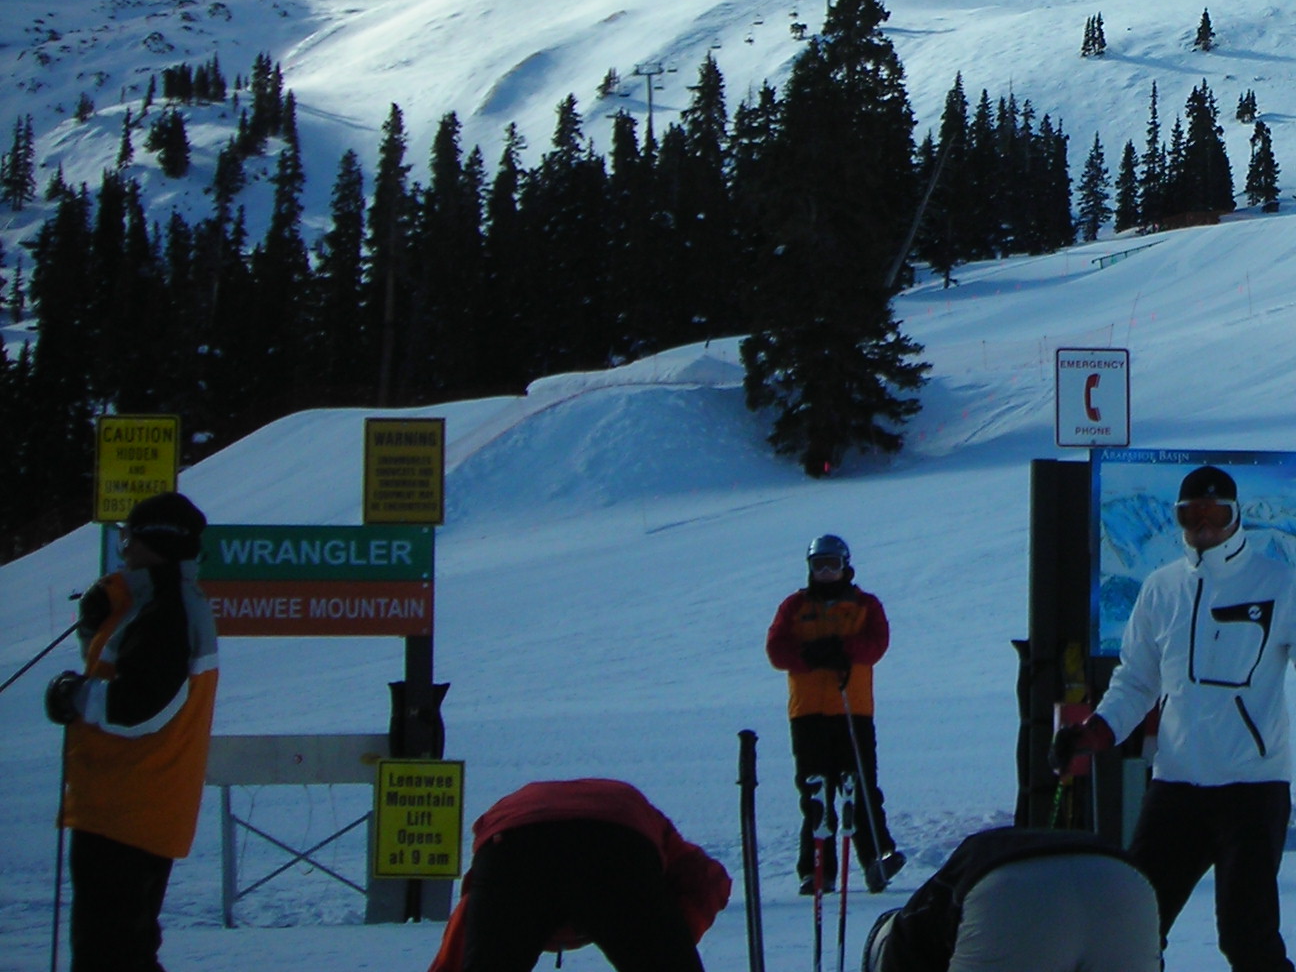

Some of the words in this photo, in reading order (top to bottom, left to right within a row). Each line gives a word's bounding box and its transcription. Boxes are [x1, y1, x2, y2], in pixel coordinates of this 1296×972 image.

[1060, 360, 1125, 369] EMERGENCY
[103, 426, 173, 443] CAUTION
[374, 431, 437, 446] WARNING
[1075, 427, 1112, 436] PHONE
[116, 446, 158, 461] HIDDEN
[128, 465, 146, 475] AND
[105, 479, 167, 494] UNMARKED
[219, 538, 413, 566] WRANGLER
[208, 597, 303, 619] ENAWEE
[309, 597, 425, 619] MOUNTAIN
[389, 772, 453, 788] Lenawee
[386, 791, 455, 807] Mountain
[407, 810, 432, 826] Lift
[397, 828, 443, 846] Opens
[389, 849, 404, 865] at
[411, 849, 420, 865] 9
[428, 853, 449, 865] am
